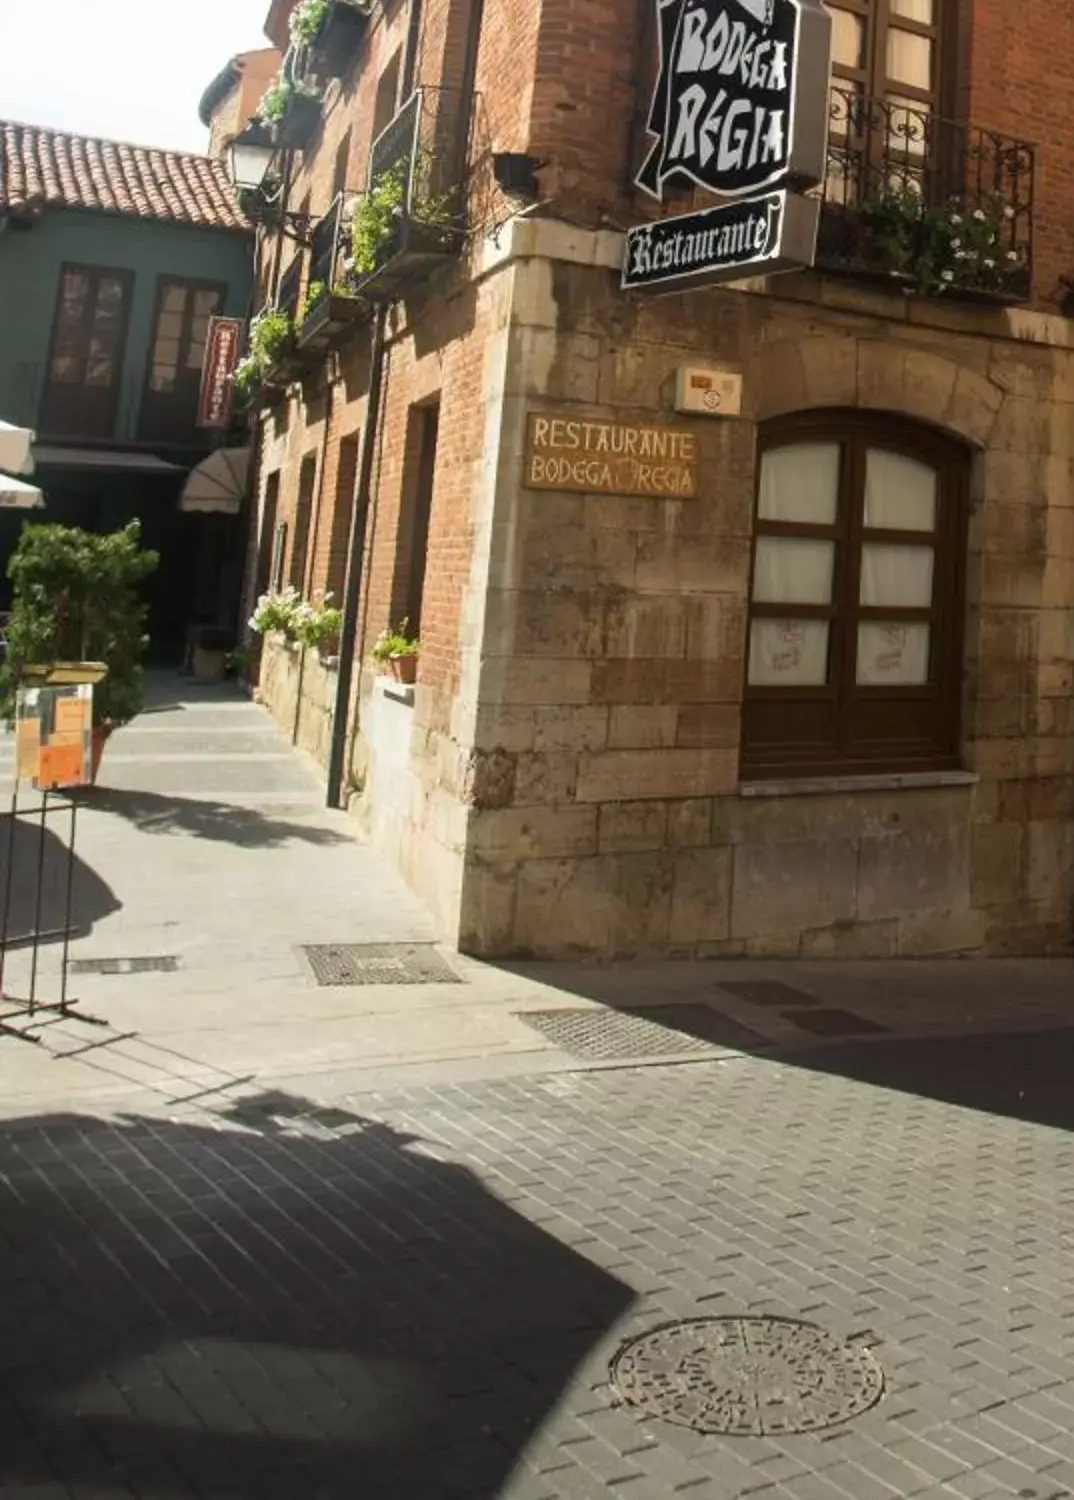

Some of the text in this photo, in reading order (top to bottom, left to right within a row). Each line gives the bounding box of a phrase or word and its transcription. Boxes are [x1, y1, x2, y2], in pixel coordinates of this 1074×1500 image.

[676, 7, 787, 90] BODEGA
[629, 213, 767, 275] Restaurante
[532, 417, 695, 460] RESTAURANTE
[531, 456, 692, 491] BODEGA REGIA
